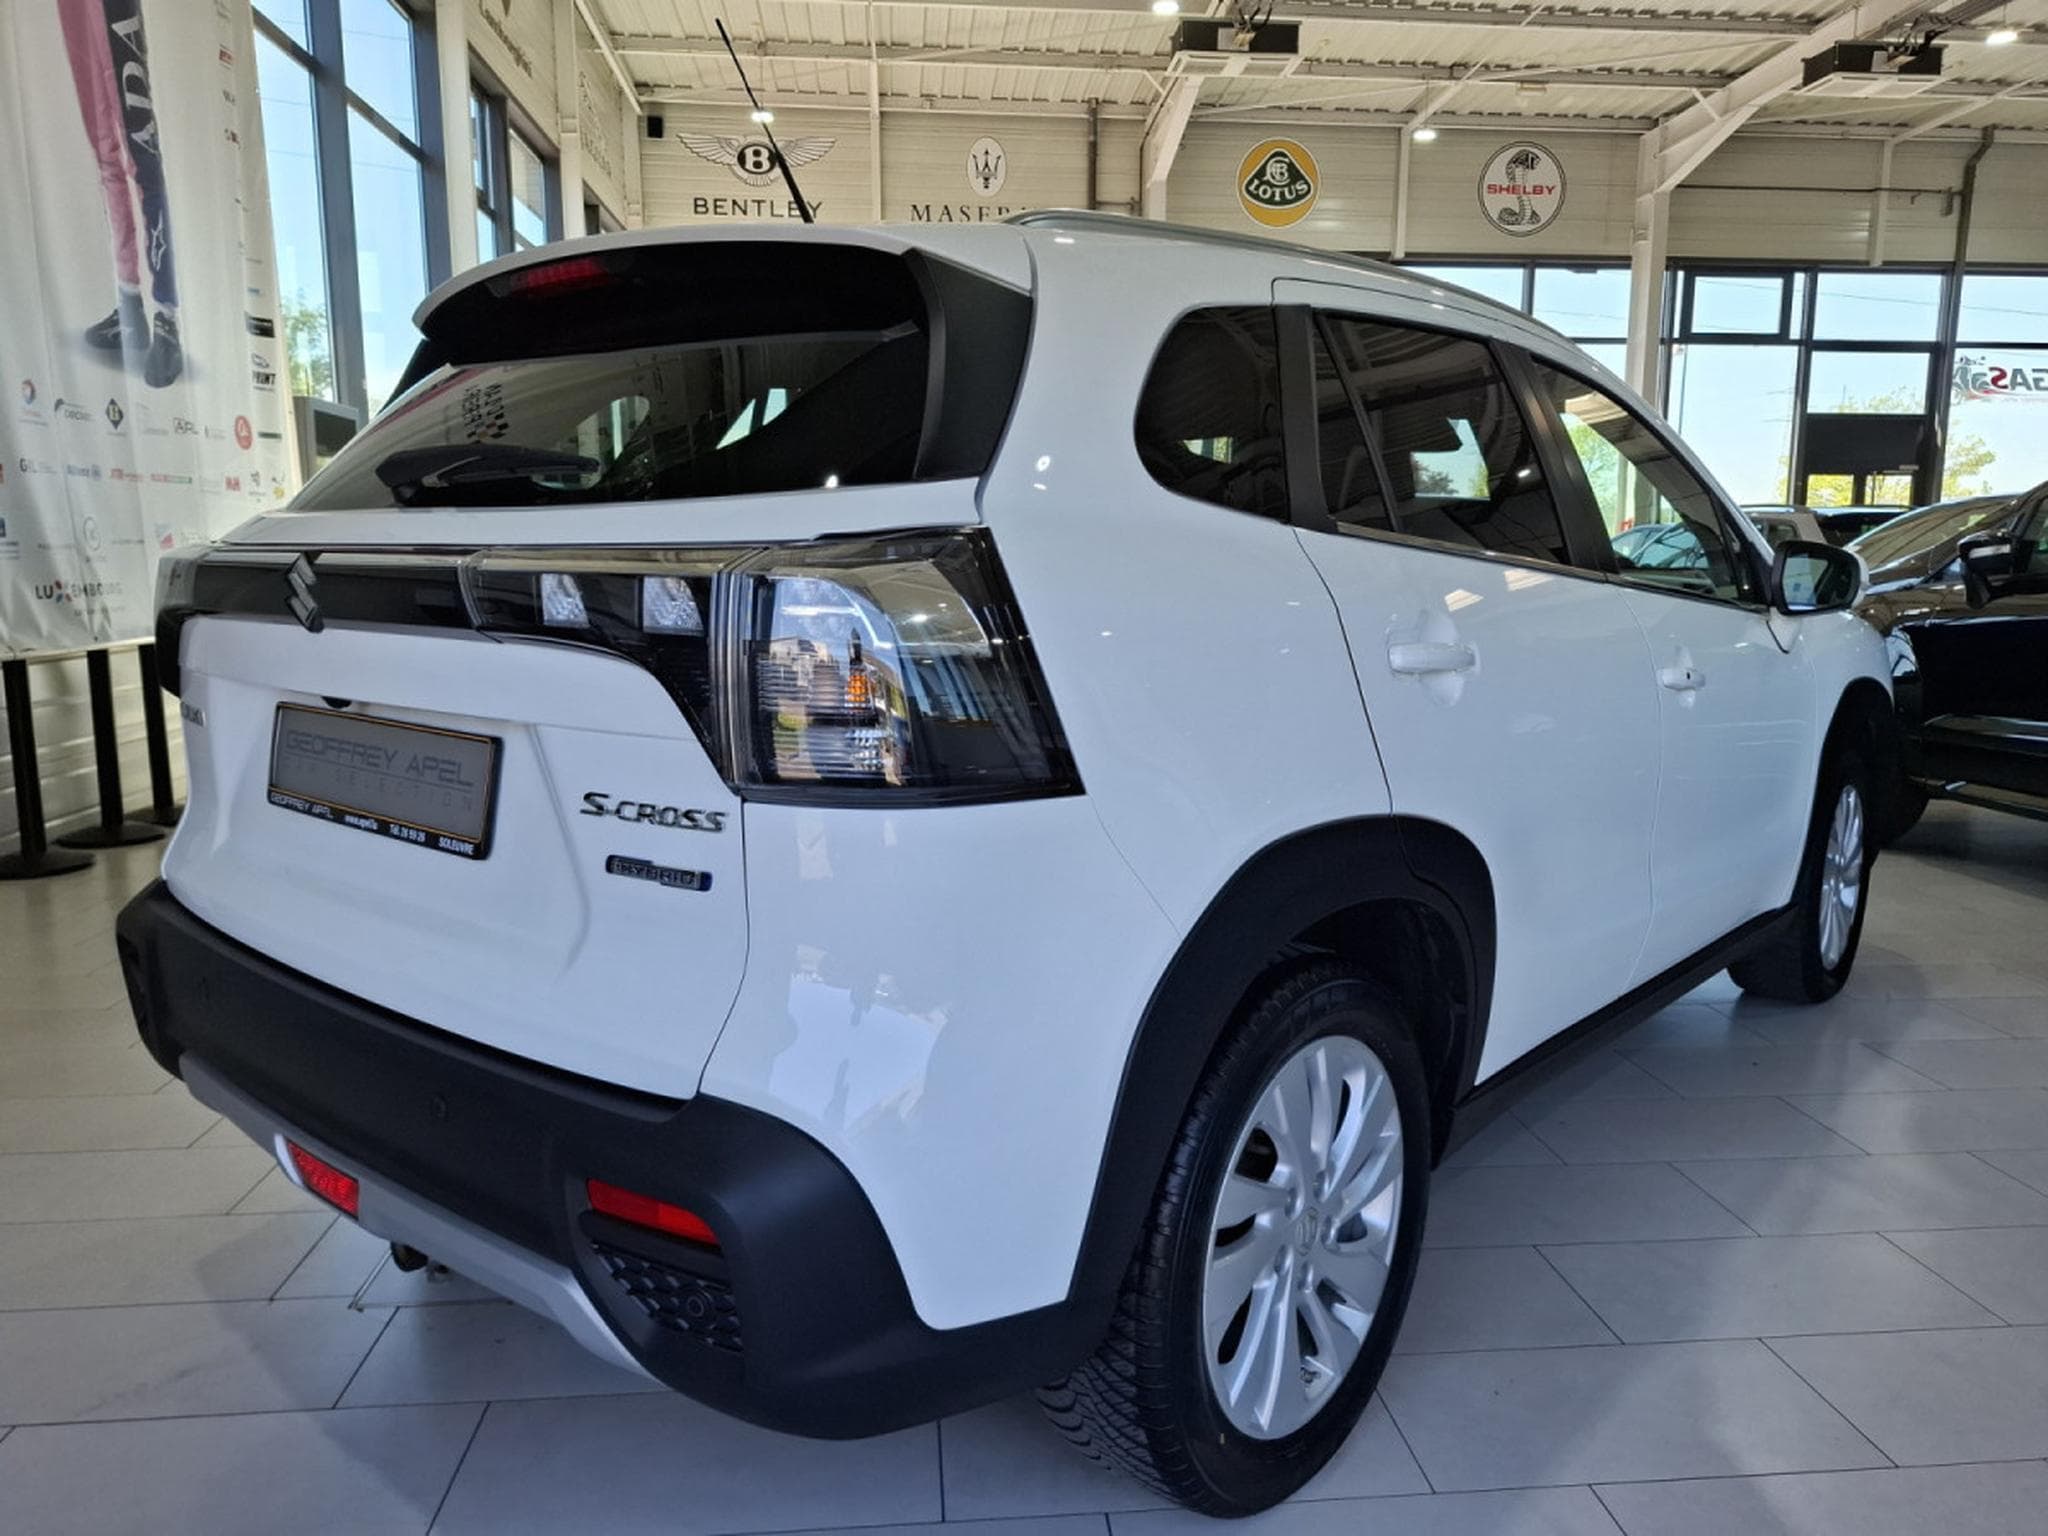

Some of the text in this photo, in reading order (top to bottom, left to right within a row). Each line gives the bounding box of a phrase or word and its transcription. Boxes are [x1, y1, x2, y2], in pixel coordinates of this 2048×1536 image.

[1248, 178, 1309, 201] LOTUS
[1486, 183, 1556, 196] SHELBY
[693, 197, 823, 219] BENTLEY
[286, 730, 475, 787] GEOFFREY APEL
